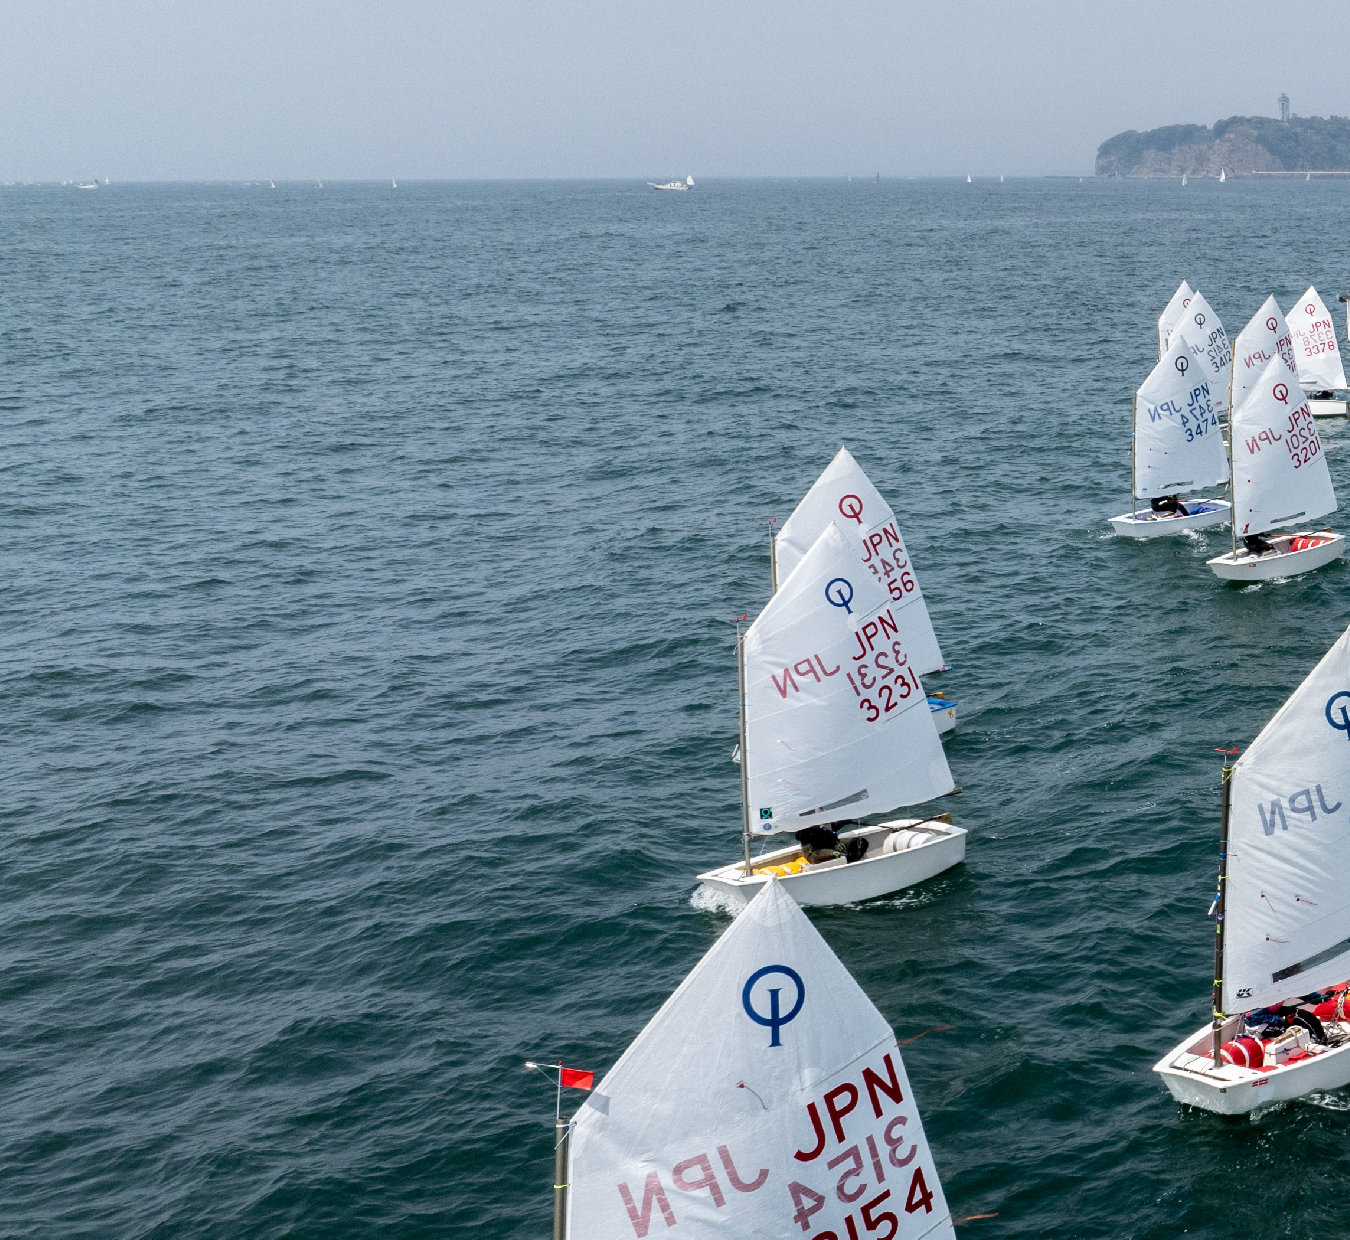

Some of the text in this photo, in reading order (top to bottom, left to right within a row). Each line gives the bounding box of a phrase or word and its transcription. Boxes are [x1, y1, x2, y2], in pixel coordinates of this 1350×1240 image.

[1208, 326, 1225, 346] JPN
[1309, 319, 1331, 334] JPN
[1274, 334, 1292, 353] JPN
[1305, 341, 1335, 356] 3378
[1212, 350, 1232, 372] 3412
[1187, 382, 1210, 406] JPN
[1185, 414, 1217, 442] 3474
[1287, 404, 1310, 433] JPN
[1292, 436, 1320, 469] 3201
[861, 522, 900, 563] JPN
[852, 609, 898, 660] JPN
[860, 666, 919, 722] 3231
[793, 1053, 904, 1162] JPN
